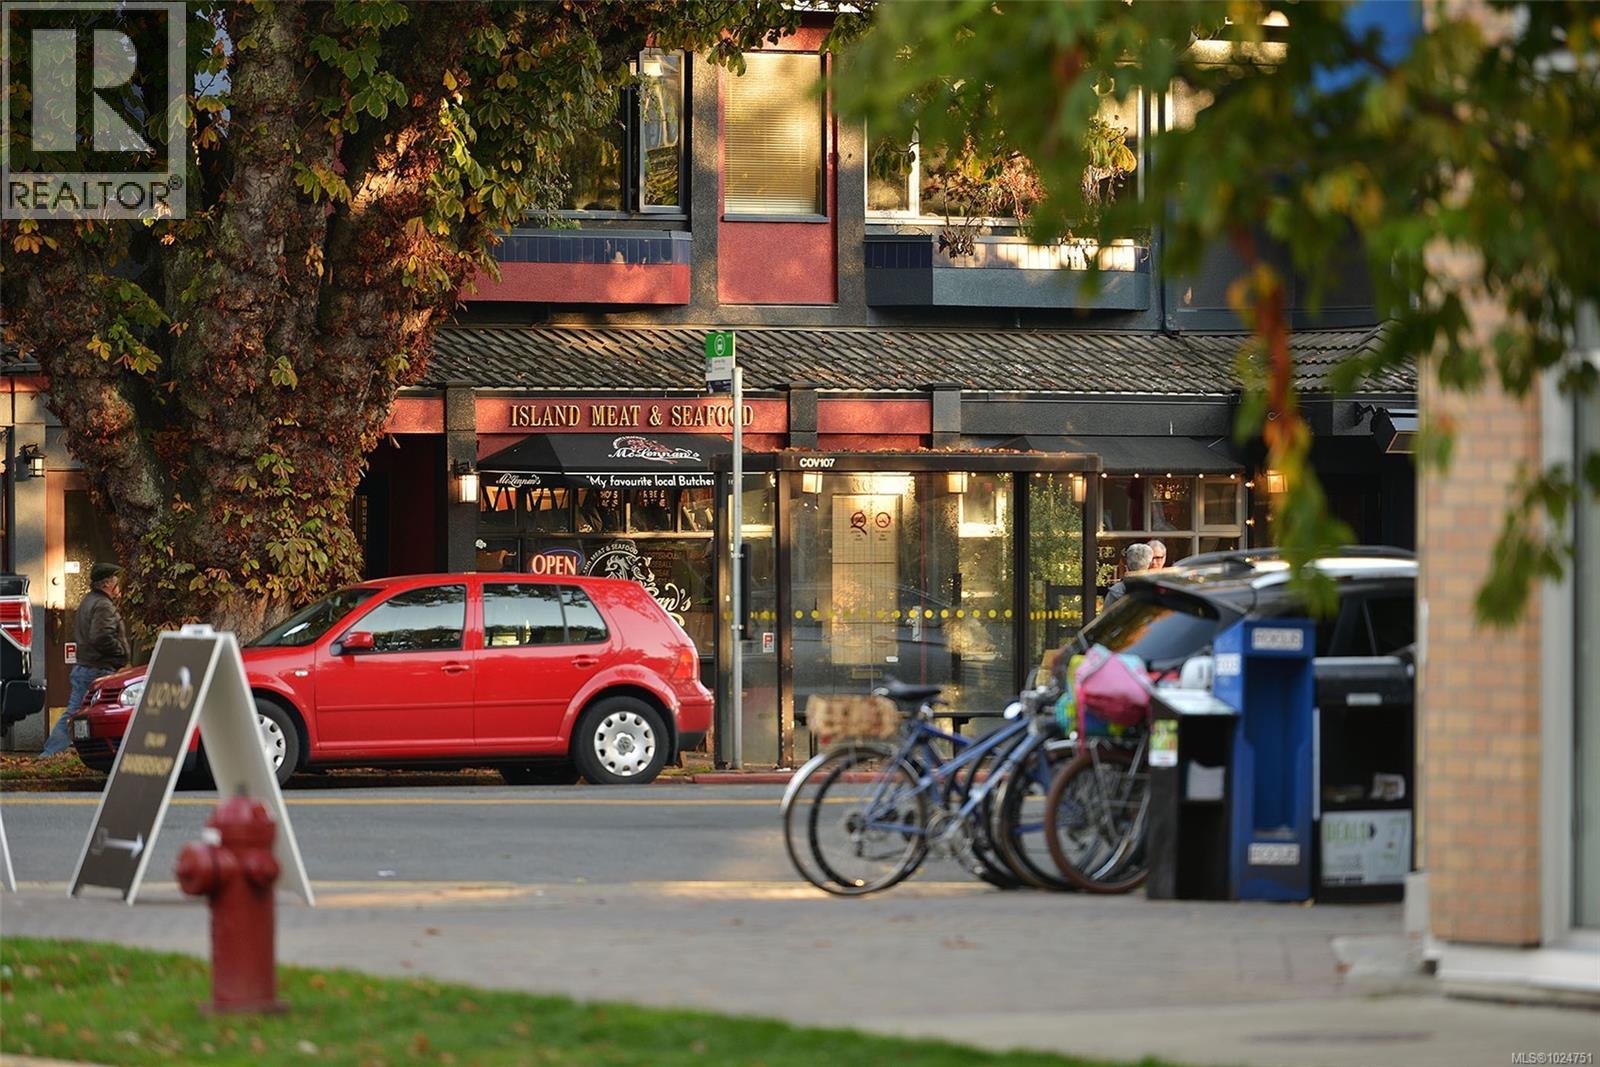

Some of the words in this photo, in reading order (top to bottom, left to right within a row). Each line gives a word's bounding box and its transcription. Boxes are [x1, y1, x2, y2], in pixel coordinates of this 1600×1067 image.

[511, 405, 581, 426] ISLAND
[591, 405, 641, 426] MEAT
[650, 405, 664, 426] &
[800, 458, 835, 467] COV107
[610, 475, 652, 486] favourite
[655, 475, 676, 486] local
[611, 543, 638, 555] SEAFOOD
[532, 554, 577, 575] OPEN
